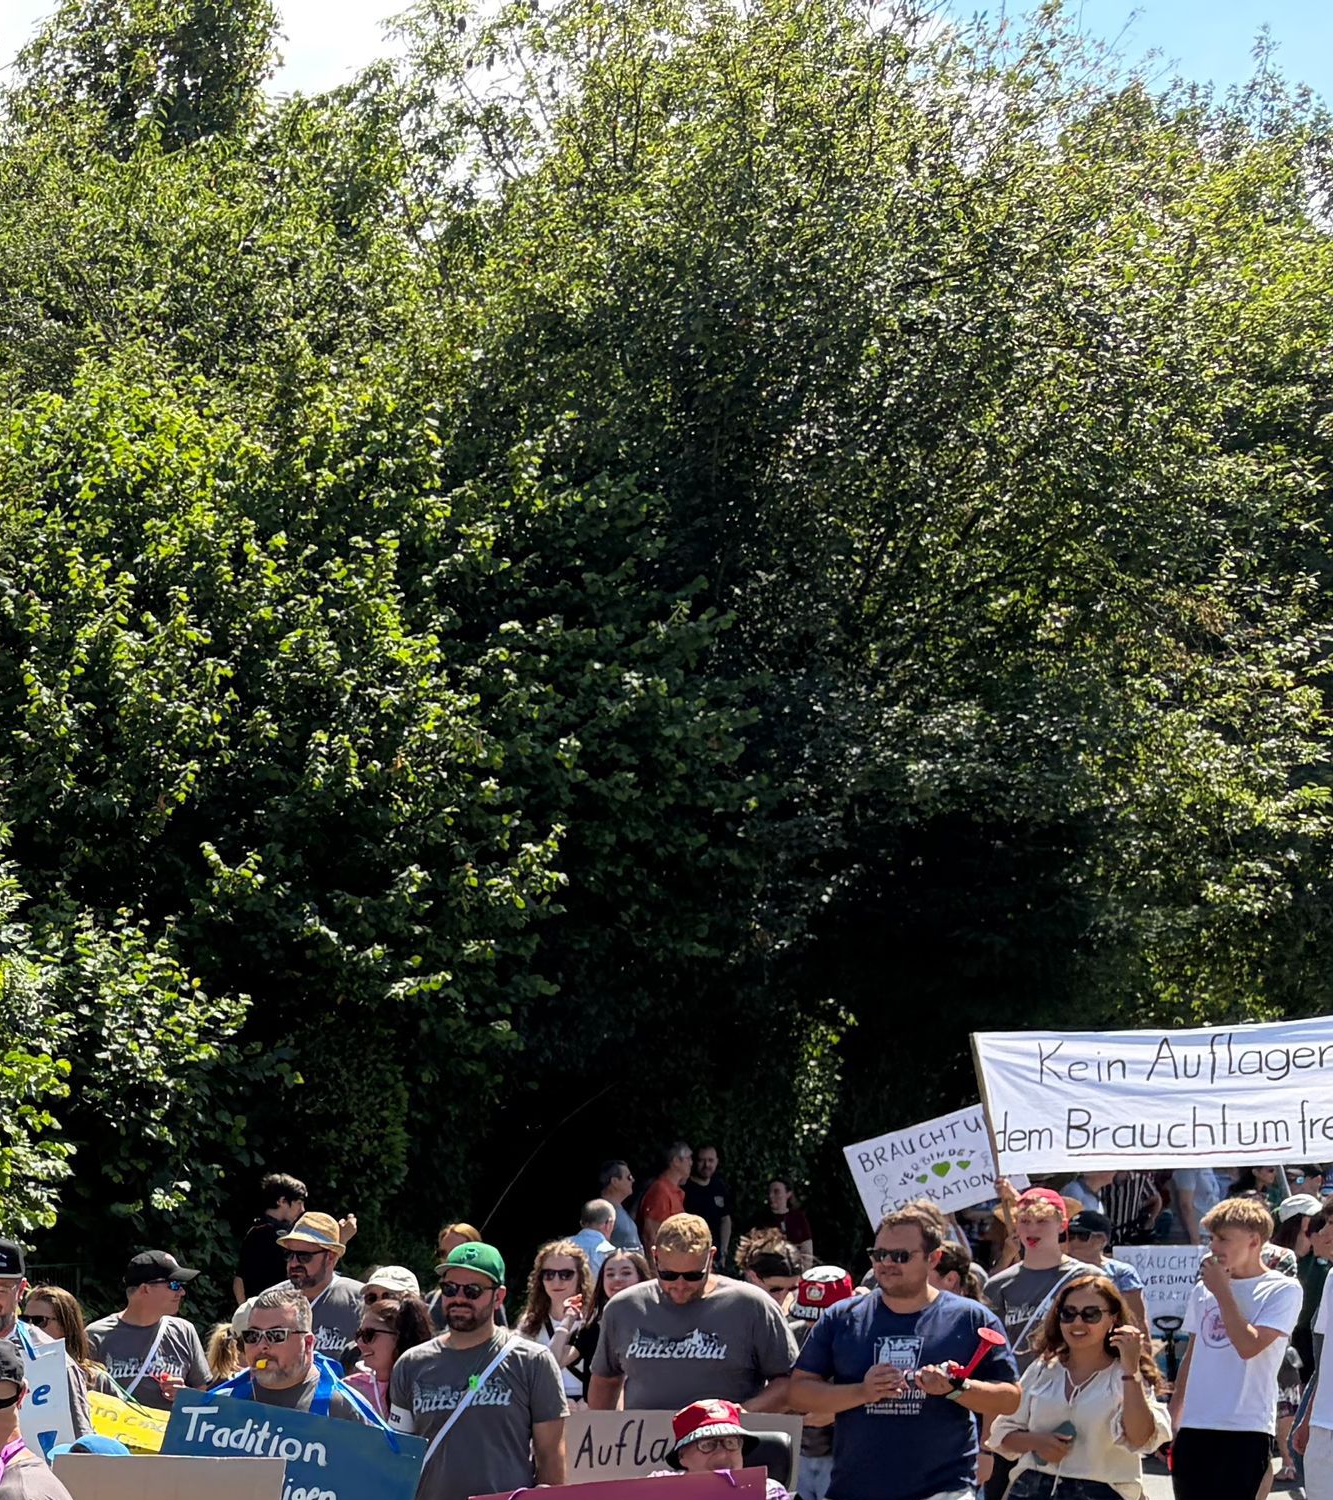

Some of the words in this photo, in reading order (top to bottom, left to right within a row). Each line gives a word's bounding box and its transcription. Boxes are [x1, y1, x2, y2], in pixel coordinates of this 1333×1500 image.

[1038, 1040, 1126, 1083] Kein
[858, 1116, 985, 1173] BRAUCHTU
[996, 1111, 1053, 1153] dem
[1066, 1104, 1290, 1150] Brauchtum
[625, 1341, 727, 1360] Pattscheid
[412, 1389, 512, 1415] Pattseid
[182, 1405, 328, 1467] Tradition
